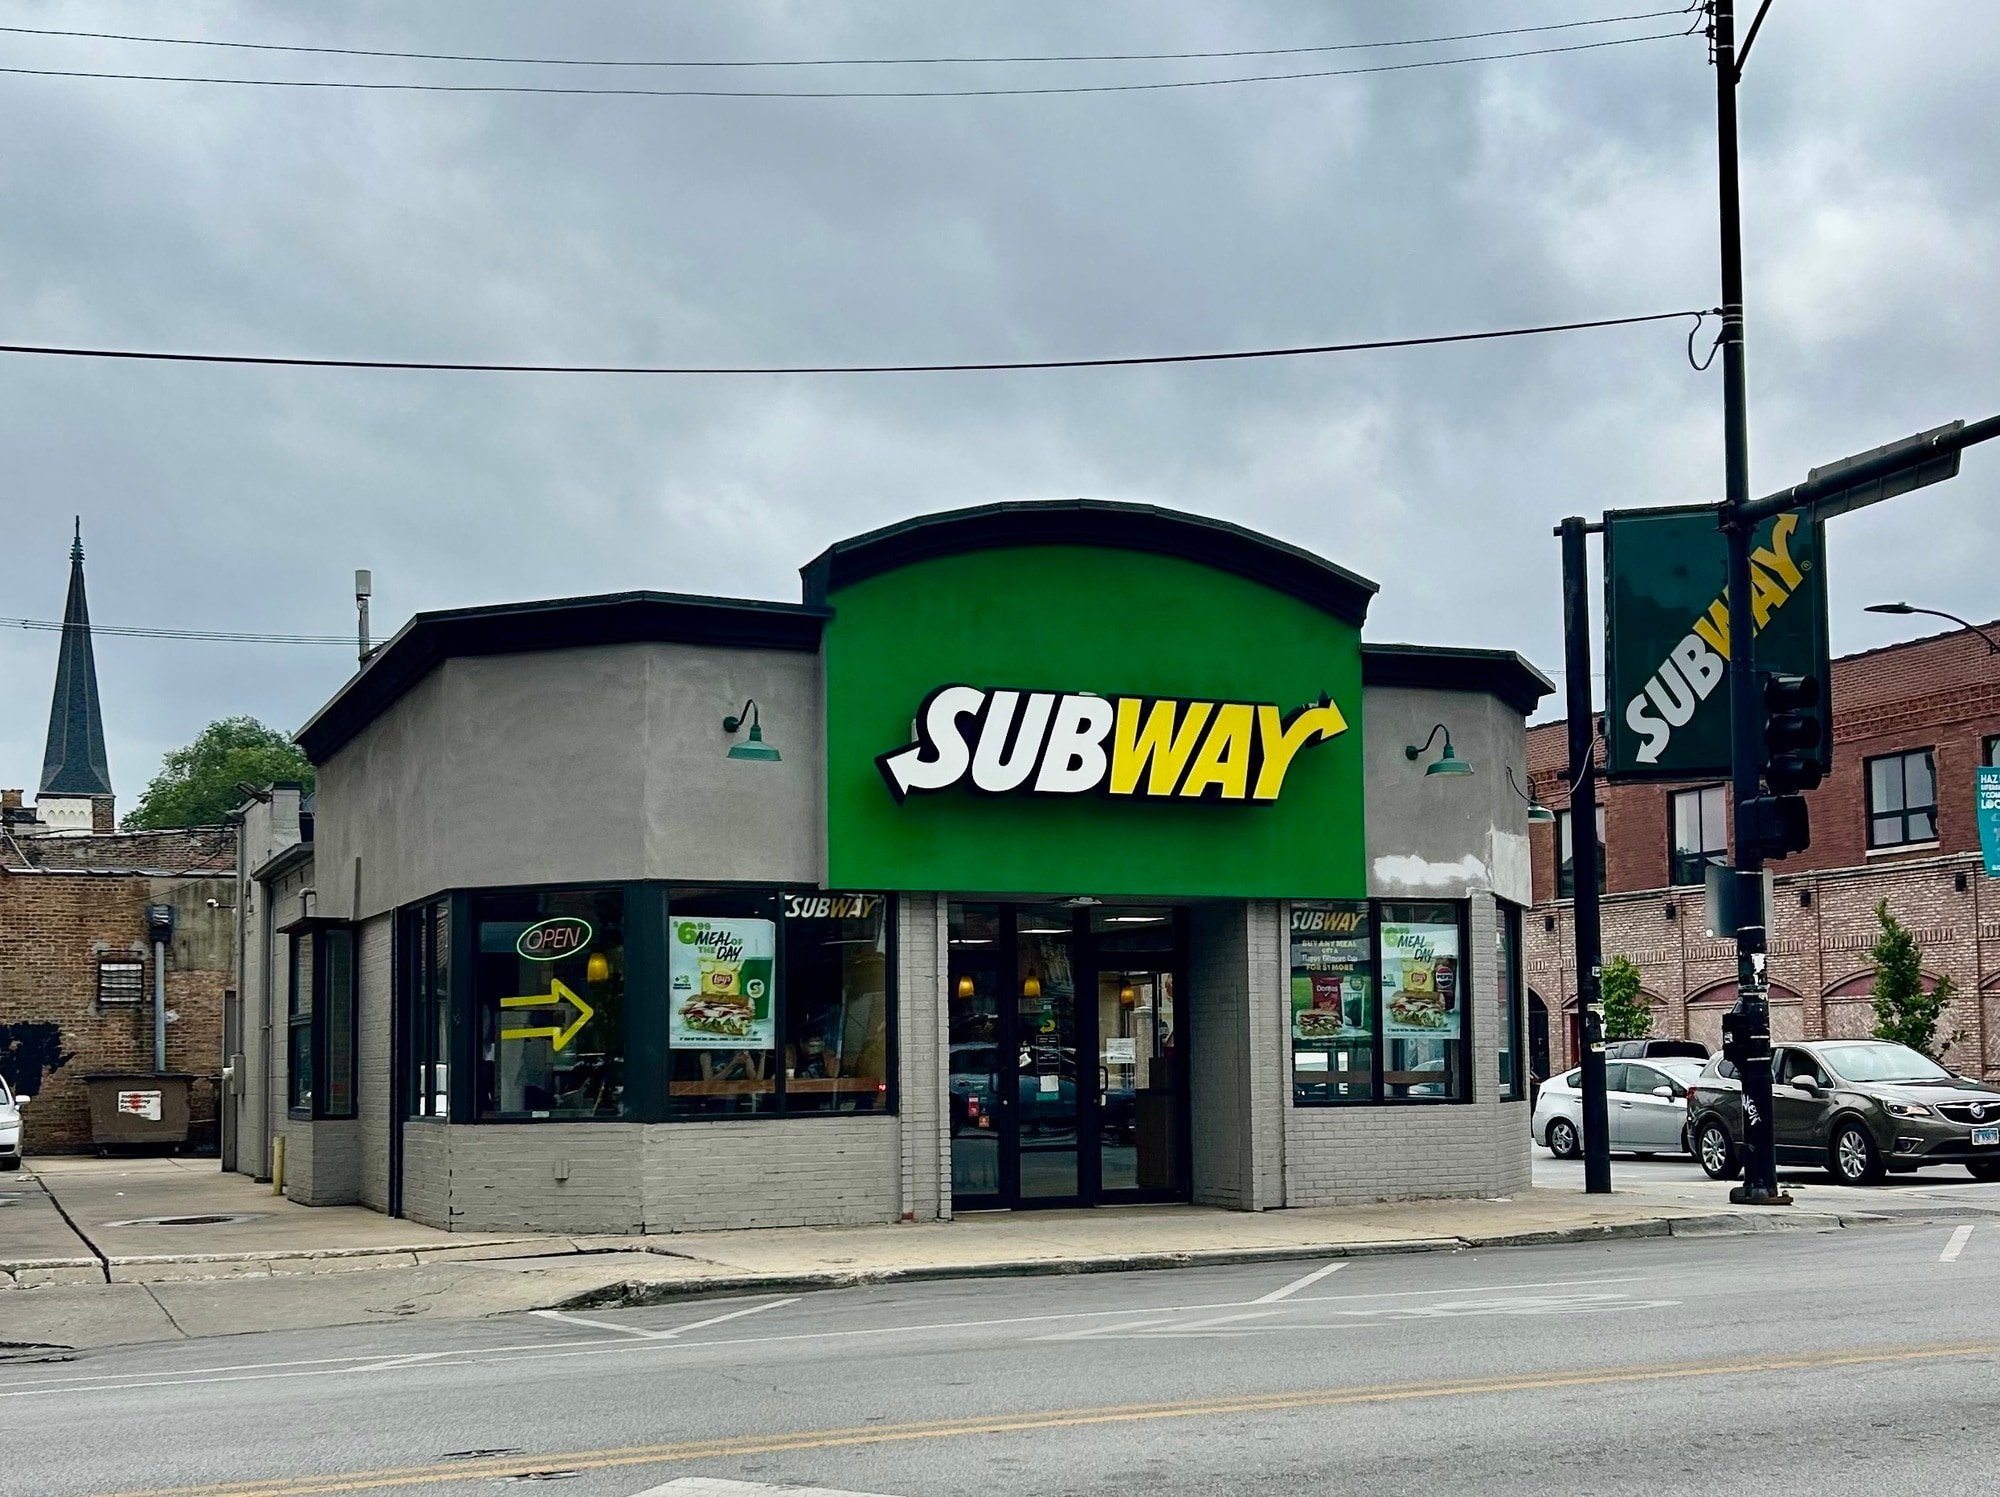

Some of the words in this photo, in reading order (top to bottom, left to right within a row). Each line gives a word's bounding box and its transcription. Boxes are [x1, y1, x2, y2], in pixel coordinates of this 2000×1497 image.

[886, 686, 1349, 801] SUBWAY
[784, 897, 882, 918] SUBWAY
[1290, 911, 1368, 931] SUBWAY
[526, 926, 581, 950] OPEN
[694, 931, 732, 946] MEAL
[1336, 940, 1357, 948] MEAL
[1397, 935, 1426, 949] MEAL
[698, 946, 715, 954] THE
[716, 946, 743, 962] DAY
[1414, 948, 1434, 963] DAY
[1331, 963, 1354, 971] MORE
